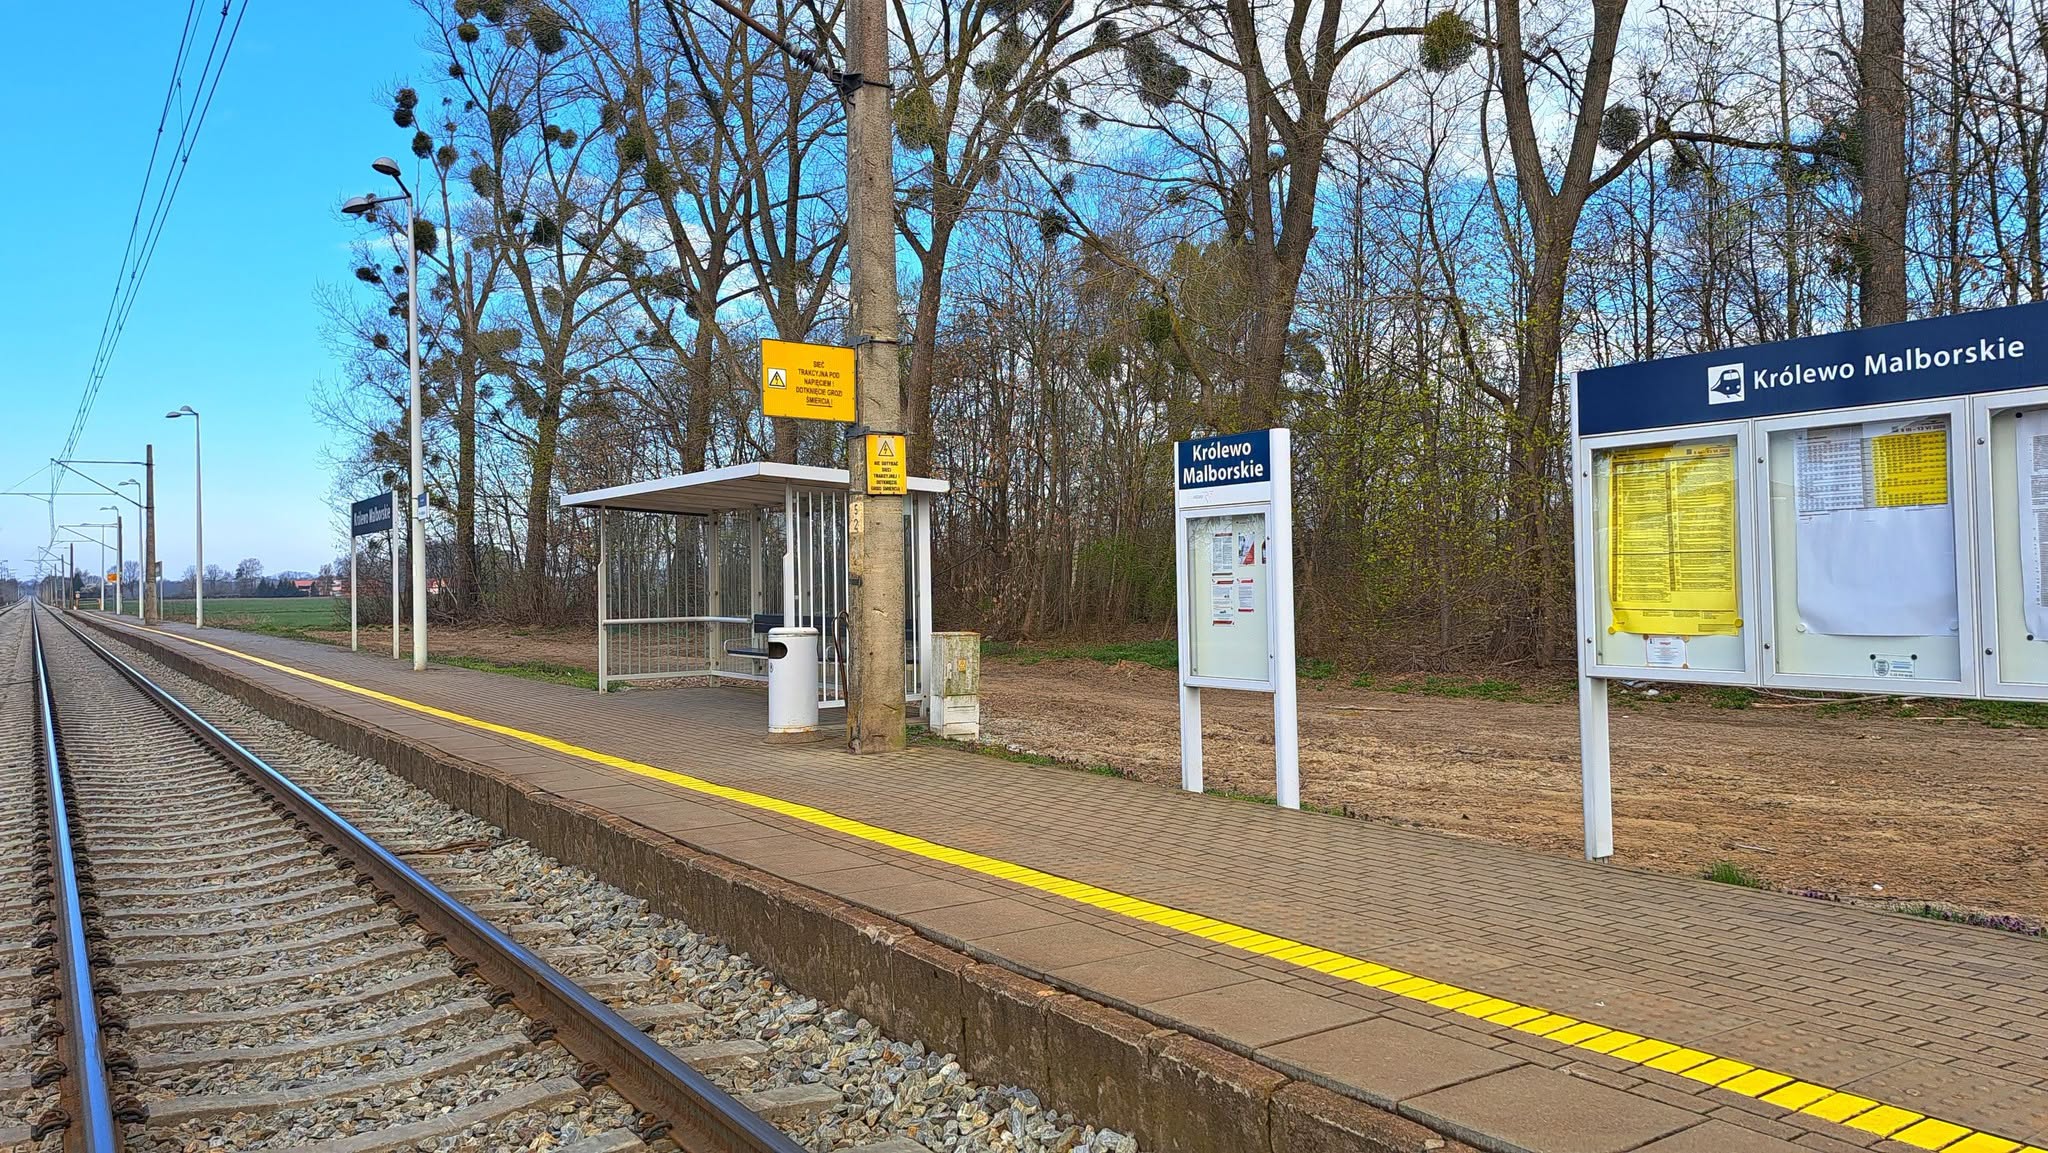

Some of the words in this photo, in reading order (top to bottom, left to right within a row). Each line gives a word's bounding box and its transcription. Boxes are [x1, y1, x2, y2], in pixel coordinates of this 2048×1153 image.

[798, 368, 828, 378] TRAKCYJNA
[1753, 363, 1855, 390] Królewo
[1864, 336, 2025, 376] Malborskie
[1192, 441, 1252, 462] Królewo
[1183, 459, 1264, 485] Malborskie
